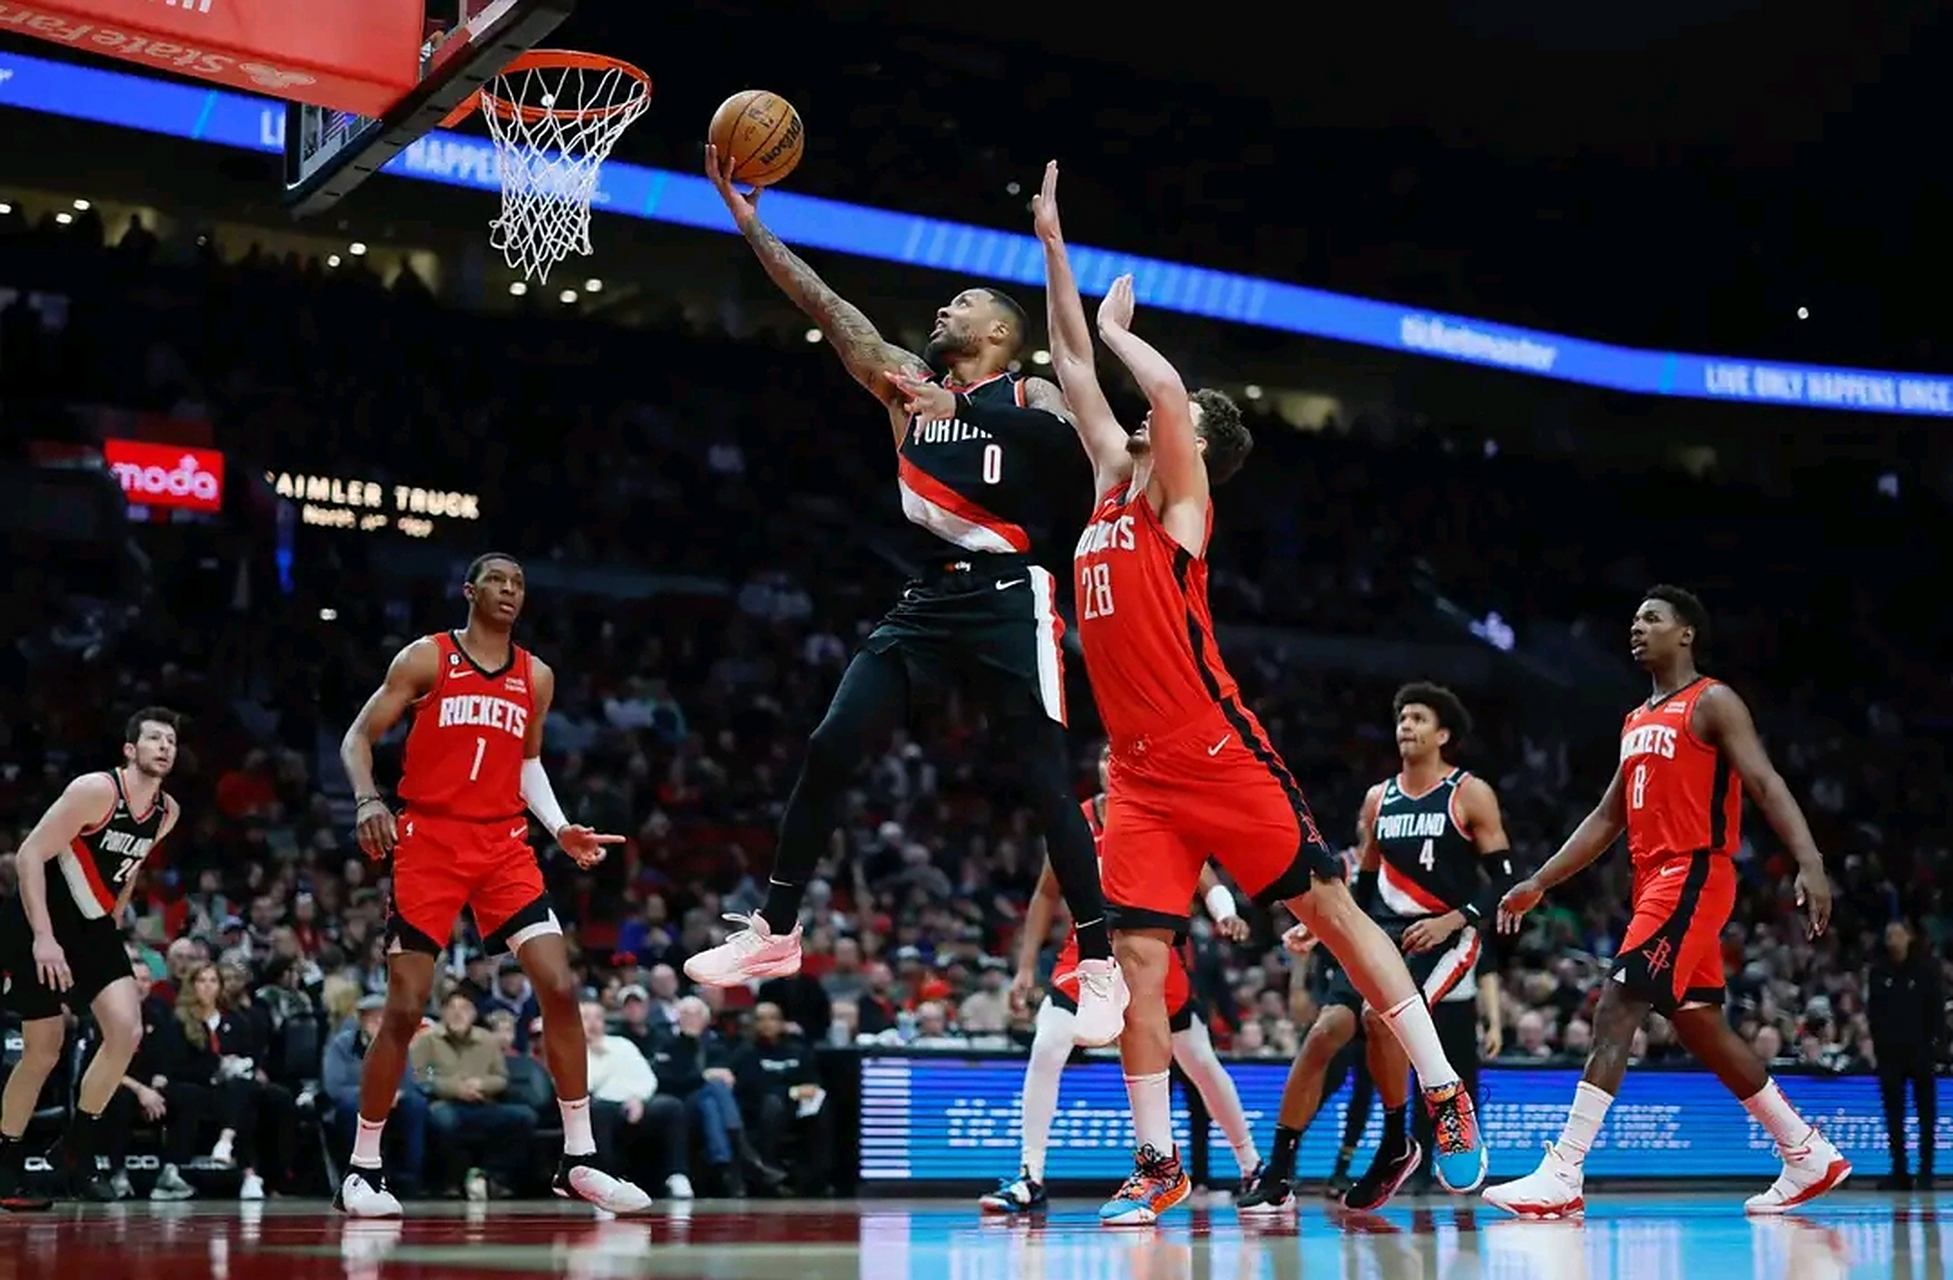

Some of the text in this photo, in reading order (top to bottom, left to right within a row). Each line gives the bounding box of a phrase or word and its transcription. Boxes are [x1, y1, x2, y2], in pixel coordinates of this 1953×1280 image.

[0, 5, 96, 42] Far
[983, 444, 1003, 485] 0
[266, 469, 383, 509] AIMLER
[394, 484, 481, 520] TRUCK
[1082, 562, 1115, 620] 28
[439, 693, 528, 740] ROCKETS
[469, 736, 486, 781] 1
[1632, 764, 1647, 810] 8
[1377, 812, 1447, 840] PORTLAND
[1419, 838, 1436, 872] 4
